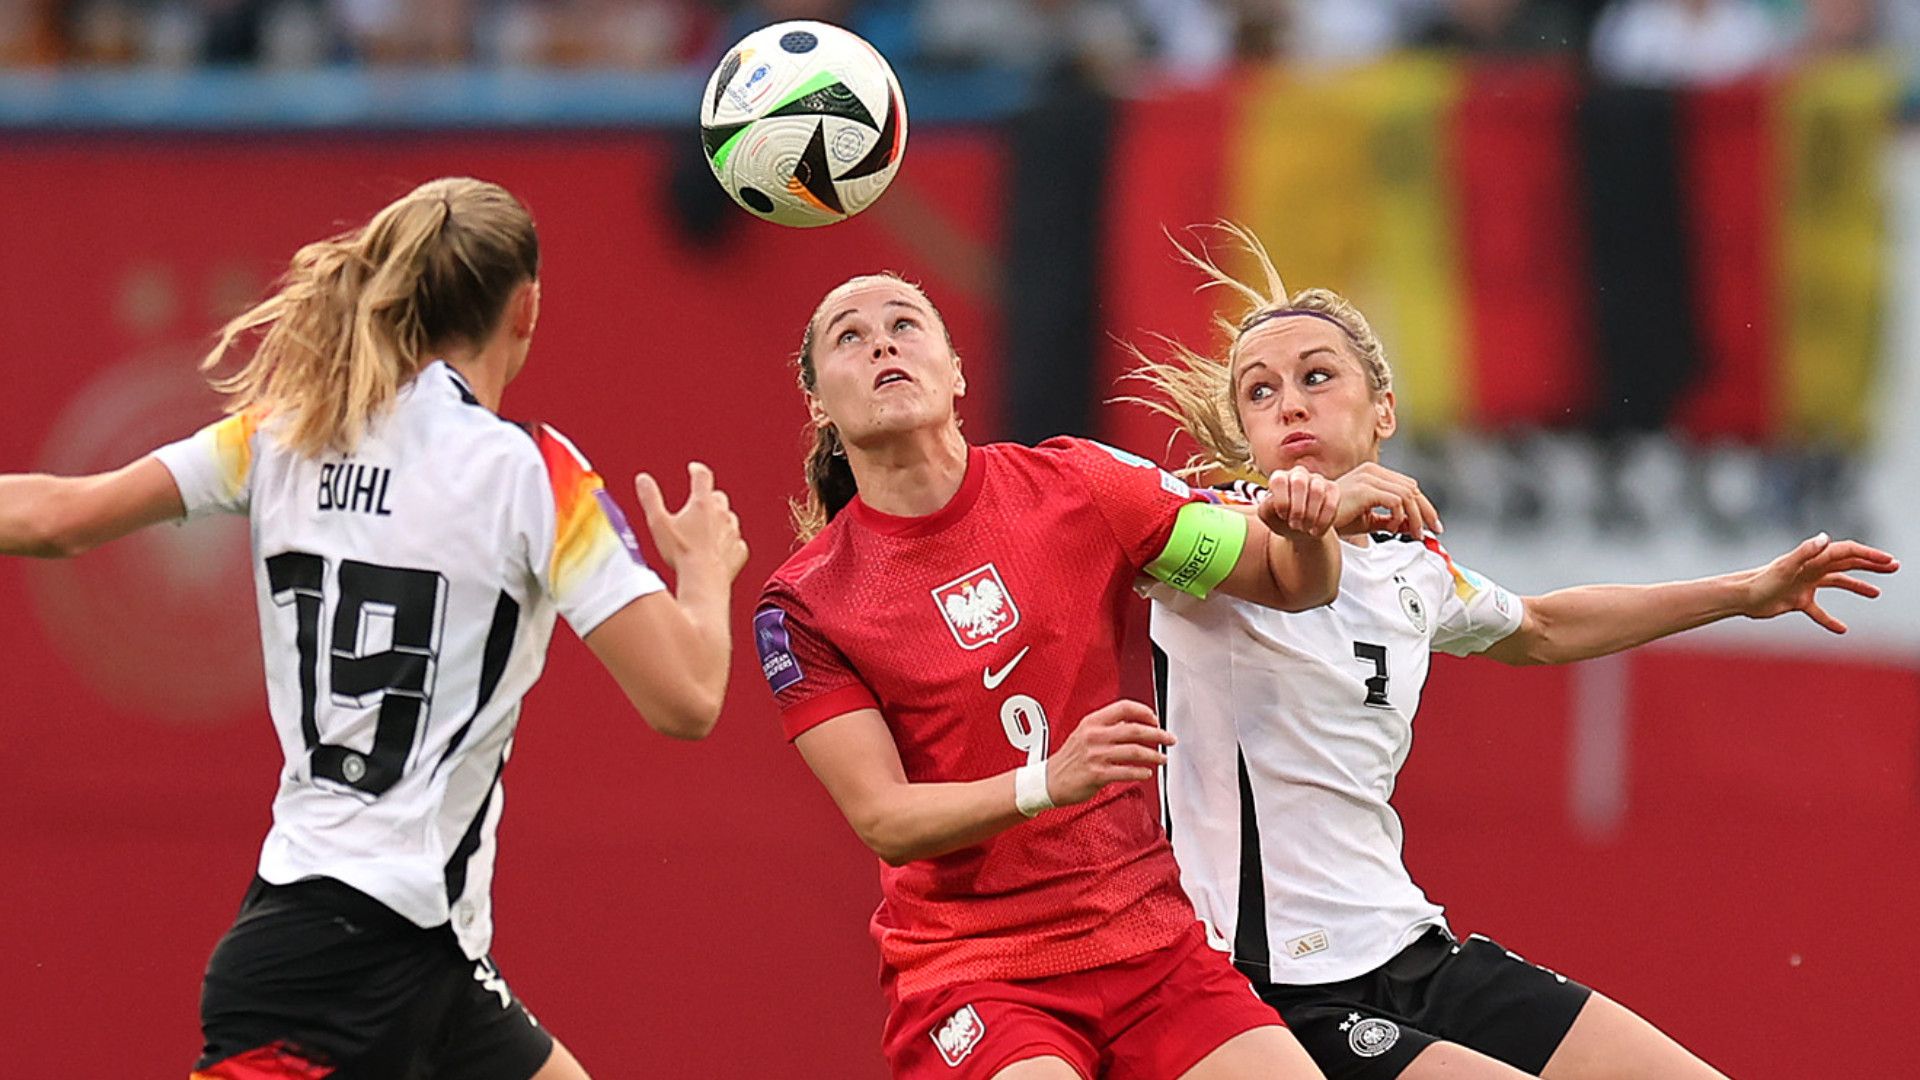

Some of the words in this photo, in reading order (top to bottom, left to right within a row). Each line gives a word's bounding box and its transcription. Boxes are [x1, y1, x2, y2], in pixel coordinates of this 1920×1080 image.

[318, 453, 392, 516] BÜHL
[1172, 534, 1215, 588] RESPECT
[265, 550, 450, 805] 19
[1000, 694, 1050, 767] 9
